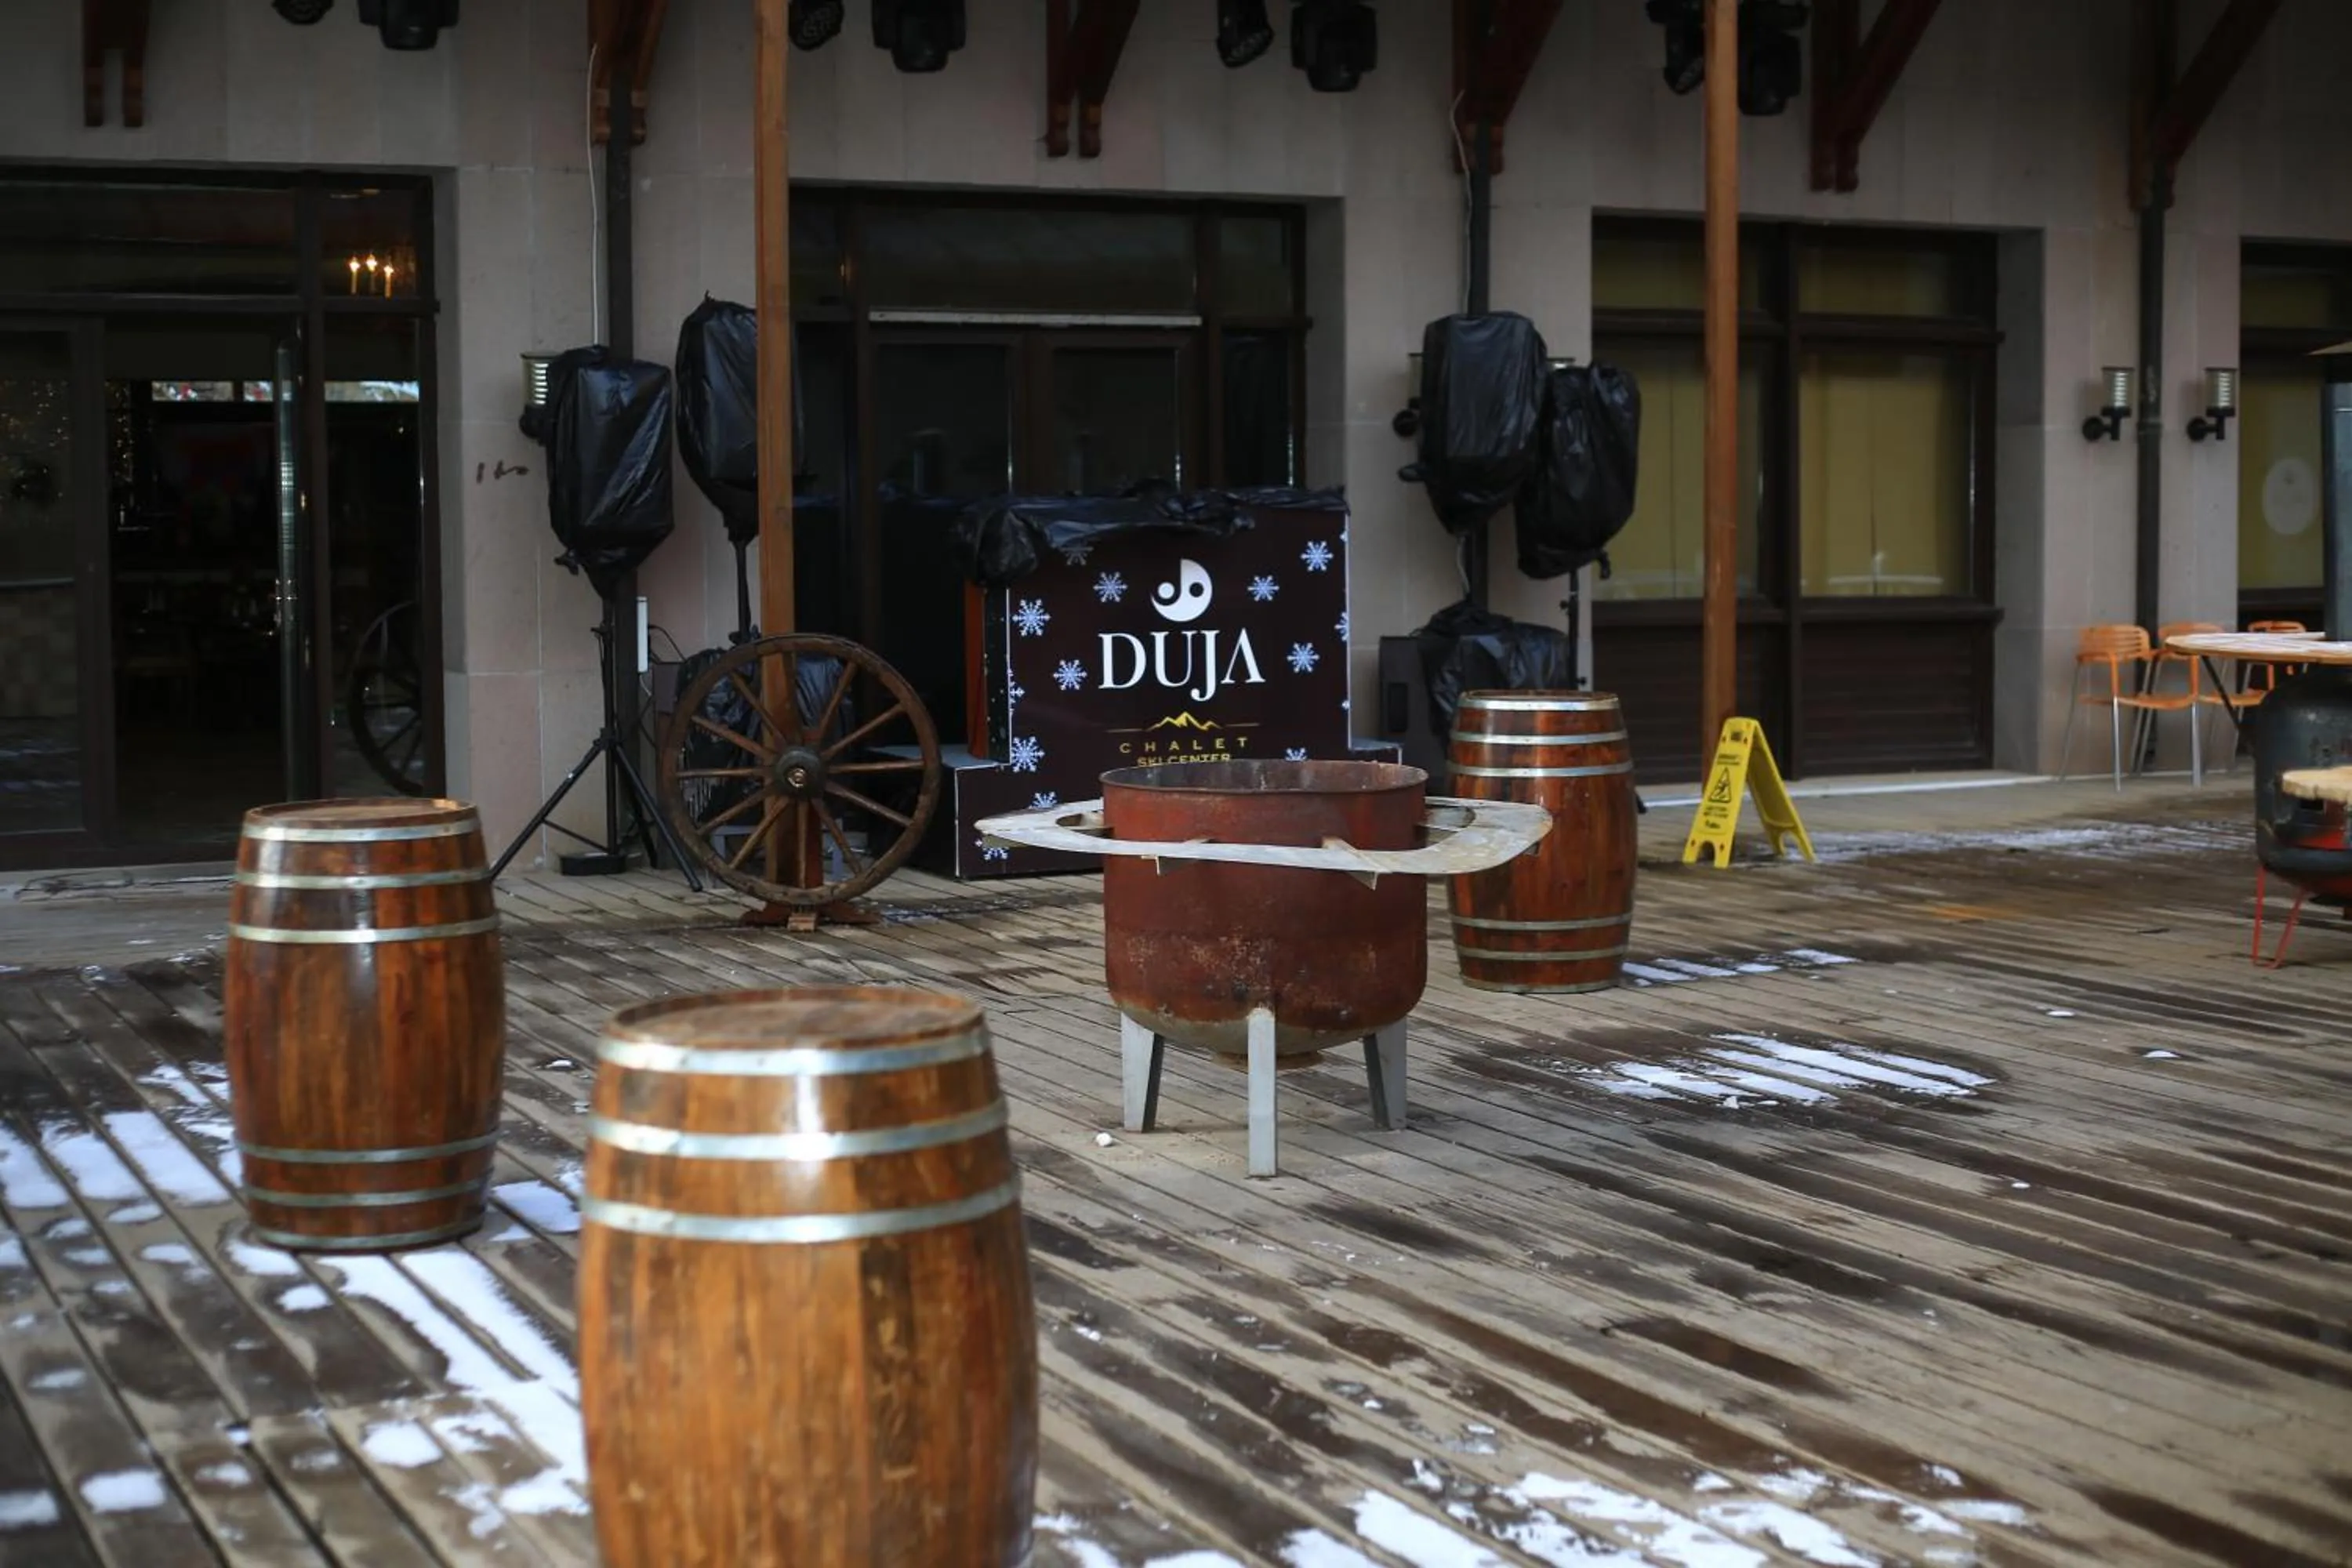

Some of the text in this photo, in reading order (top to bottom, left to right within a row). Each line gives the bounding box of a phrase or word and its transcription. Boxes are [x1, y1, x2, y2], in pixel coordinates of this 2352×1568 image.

[1098, 627, 1266, 702] DUJA
[1120, 737, 1248, 754] CHALET
[1167, 753, 1231, 764] CENTER
